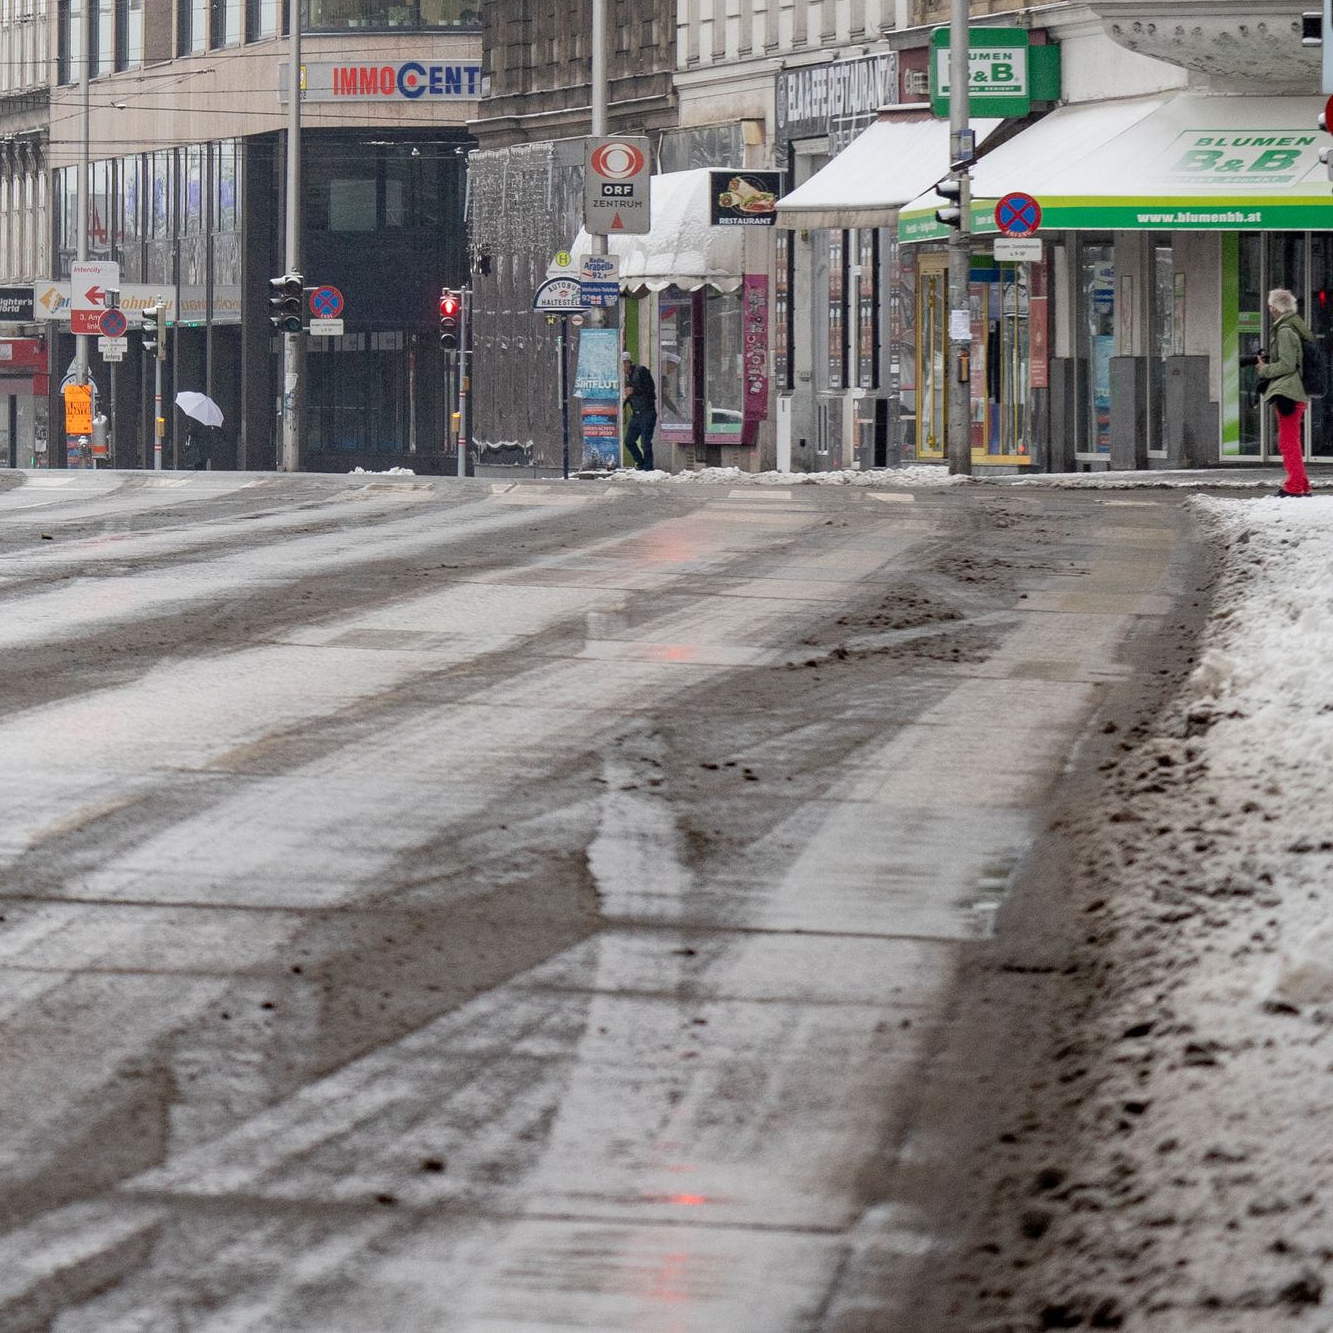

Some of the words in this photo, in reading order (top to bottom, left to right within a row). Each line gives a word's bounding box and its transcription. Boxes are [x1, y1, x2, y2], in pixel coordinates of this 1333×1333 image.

[948, 52, 1013, 61] UMEN
[333, 62, 483, 99] IMMOCENT
[1193, 137, 1318, 147] BLUMEN
[604, 185, 632, 195] ORF
[593, 200, 642, 208] ZENTRUM
[719, 217, 771, 226] RESTAURANT
[1137, 211, 1262, 223] www.blumenbb.at
[559, 254, 568, 265] H
[73, 267, 102, 275] Intercity
[541, 298, 582, 306] HALTESTEL
